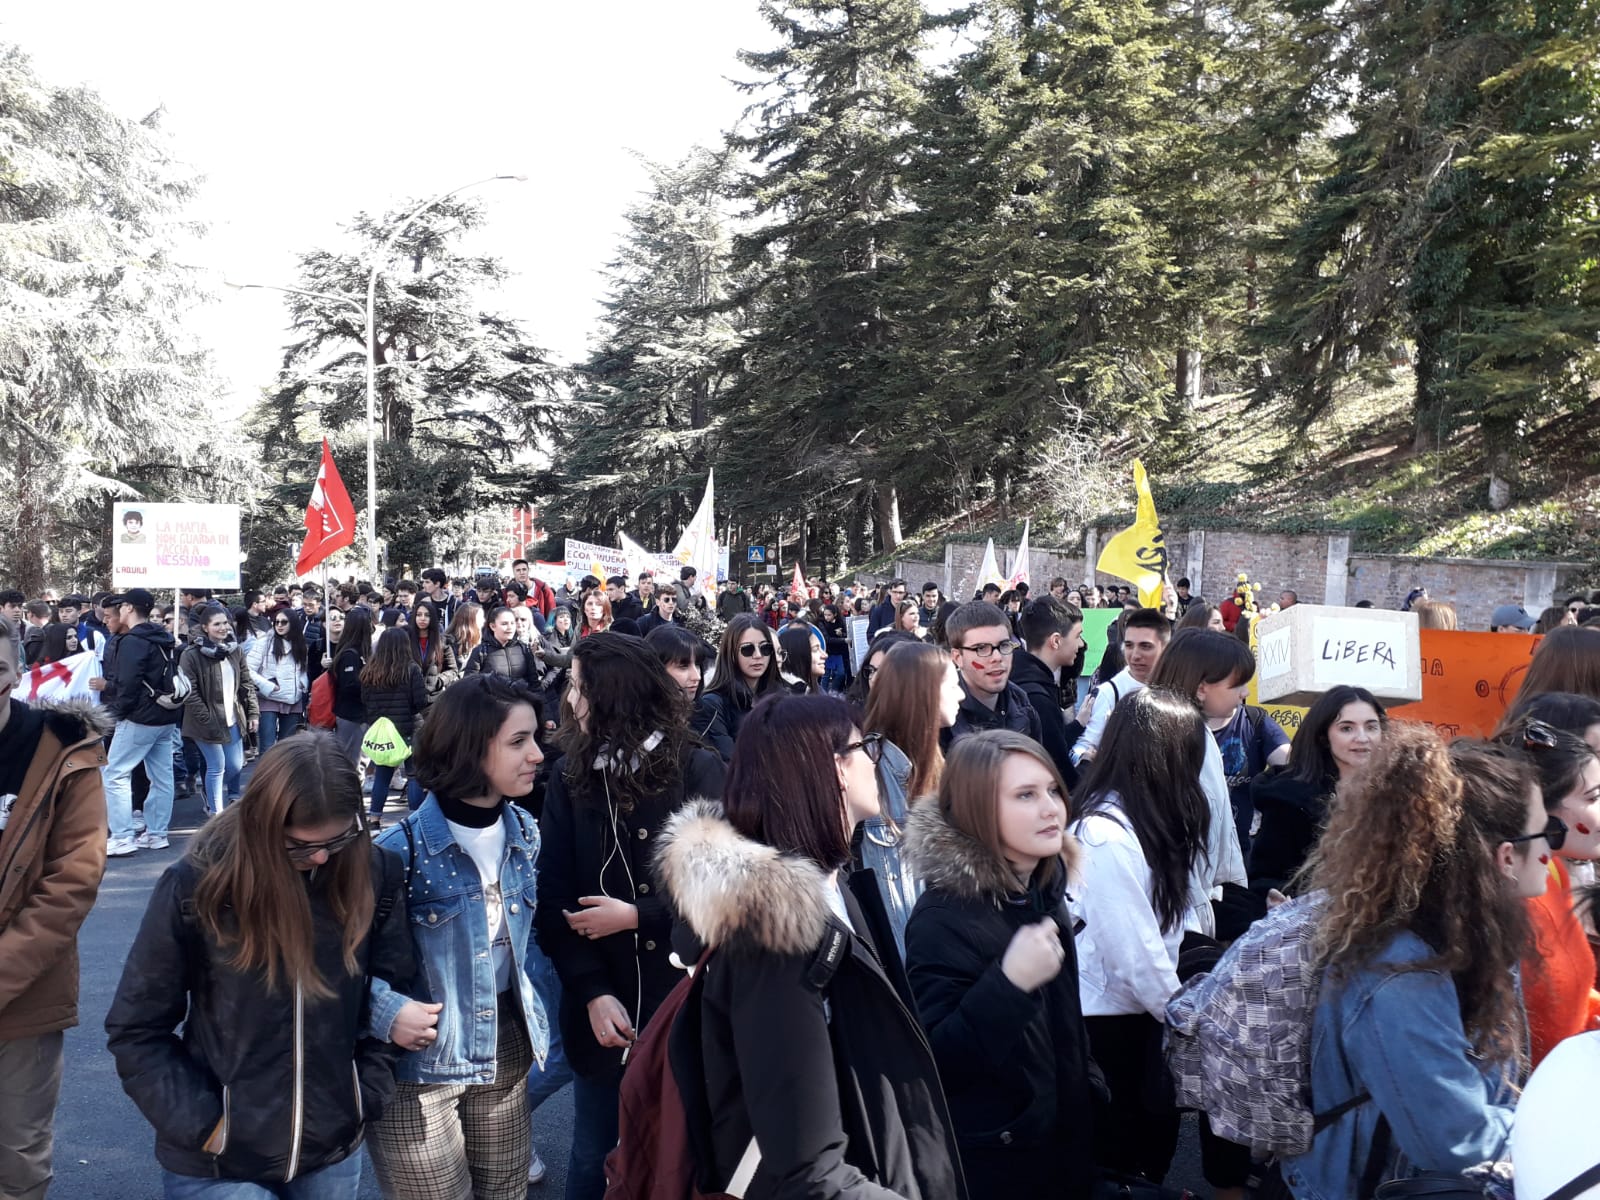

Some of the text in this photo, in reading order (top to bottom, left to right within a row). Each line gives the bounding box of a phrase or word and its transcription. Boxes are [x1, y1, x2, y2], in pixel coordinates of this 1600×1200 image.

[156, 521, 171, 532] LA
[156, 533, 176, 544] NON
[179, 533, 217, 545] GUARDA
[156, 544, 200, 555] FACCIA A
[156, 554, 211, 567] NESSUNO
[1261, 636, 1290, 667] XXIV
